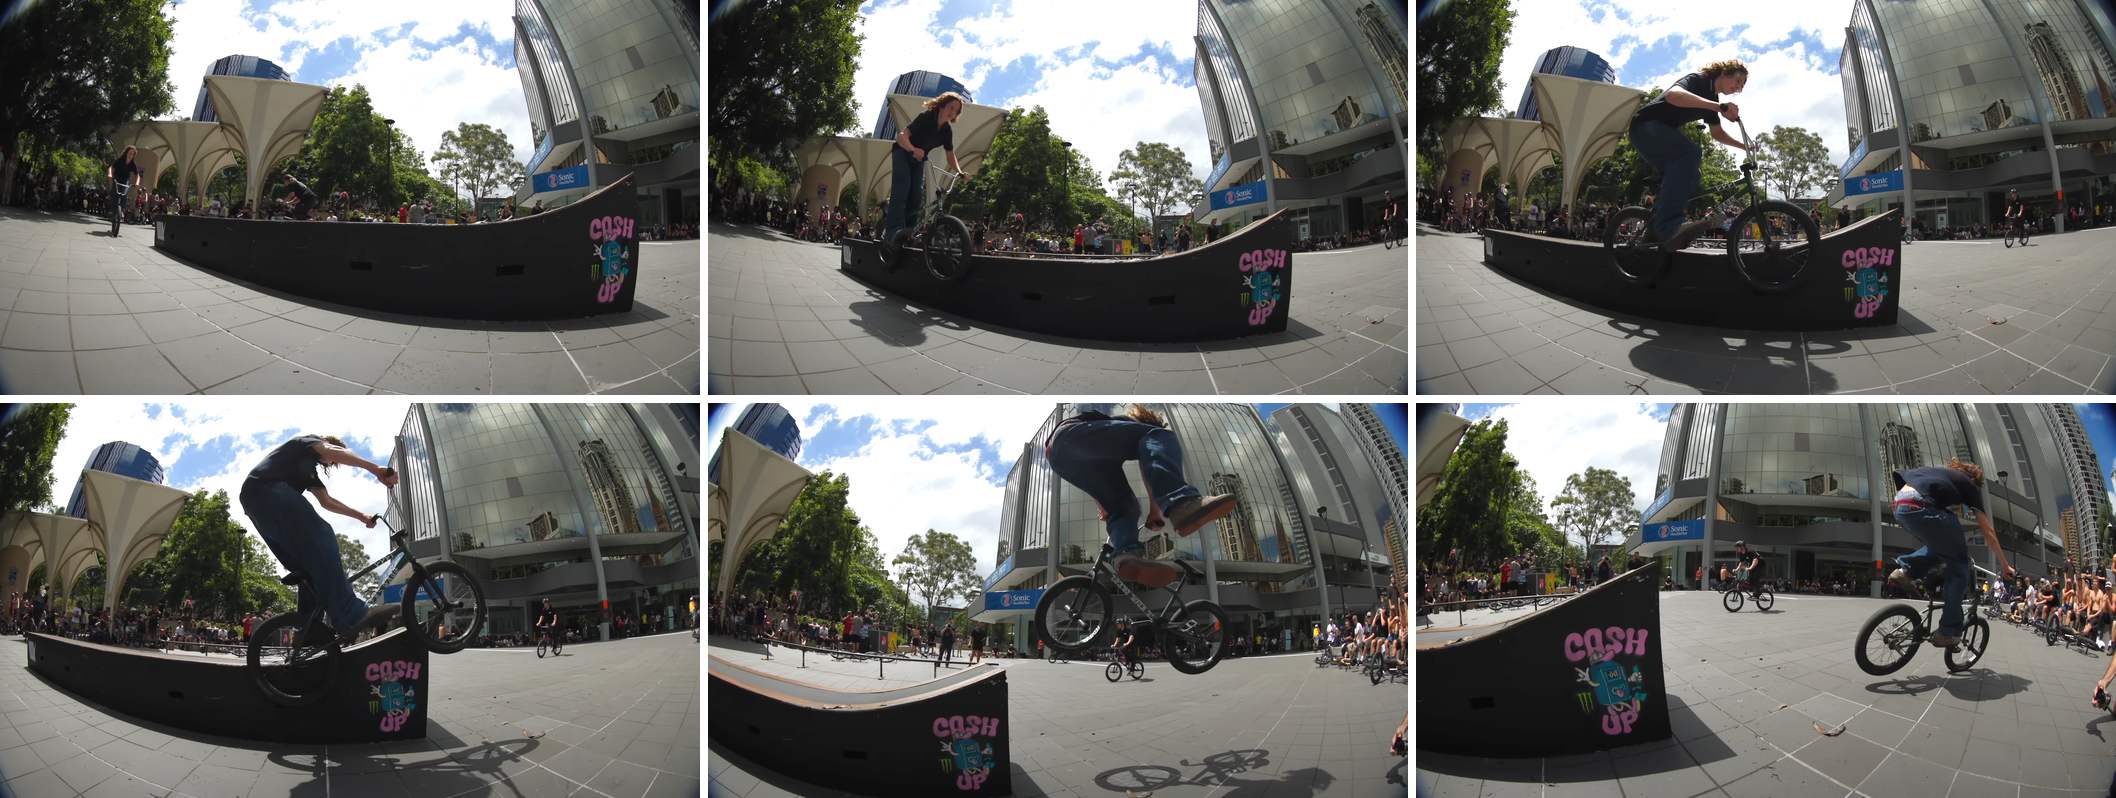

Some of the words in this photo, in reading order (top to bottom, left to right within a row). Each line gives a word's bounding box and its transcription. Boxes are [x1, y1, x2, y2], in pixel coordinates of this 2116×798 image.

[1872, 177, 1888, 185] Sonic
[590, 216, 635, 241] CASH
[1238, 248, 1287, 272] CASH
[1842, 247, 1895, 270] CASH
[597, 281, 624, 303] UP
[1248, 305, 1276, 326] UP
[1854, 300, 1882, 319] UP
[1564, 627, 1649, 662] CASH
[365, 661, 422, 681] CASH
[380, 713, 408, 732] UP
[932, 716, 1000, 739] CASH
[1601, 703, 1639, 735] UP
[956, 771, 989, 791] UP
